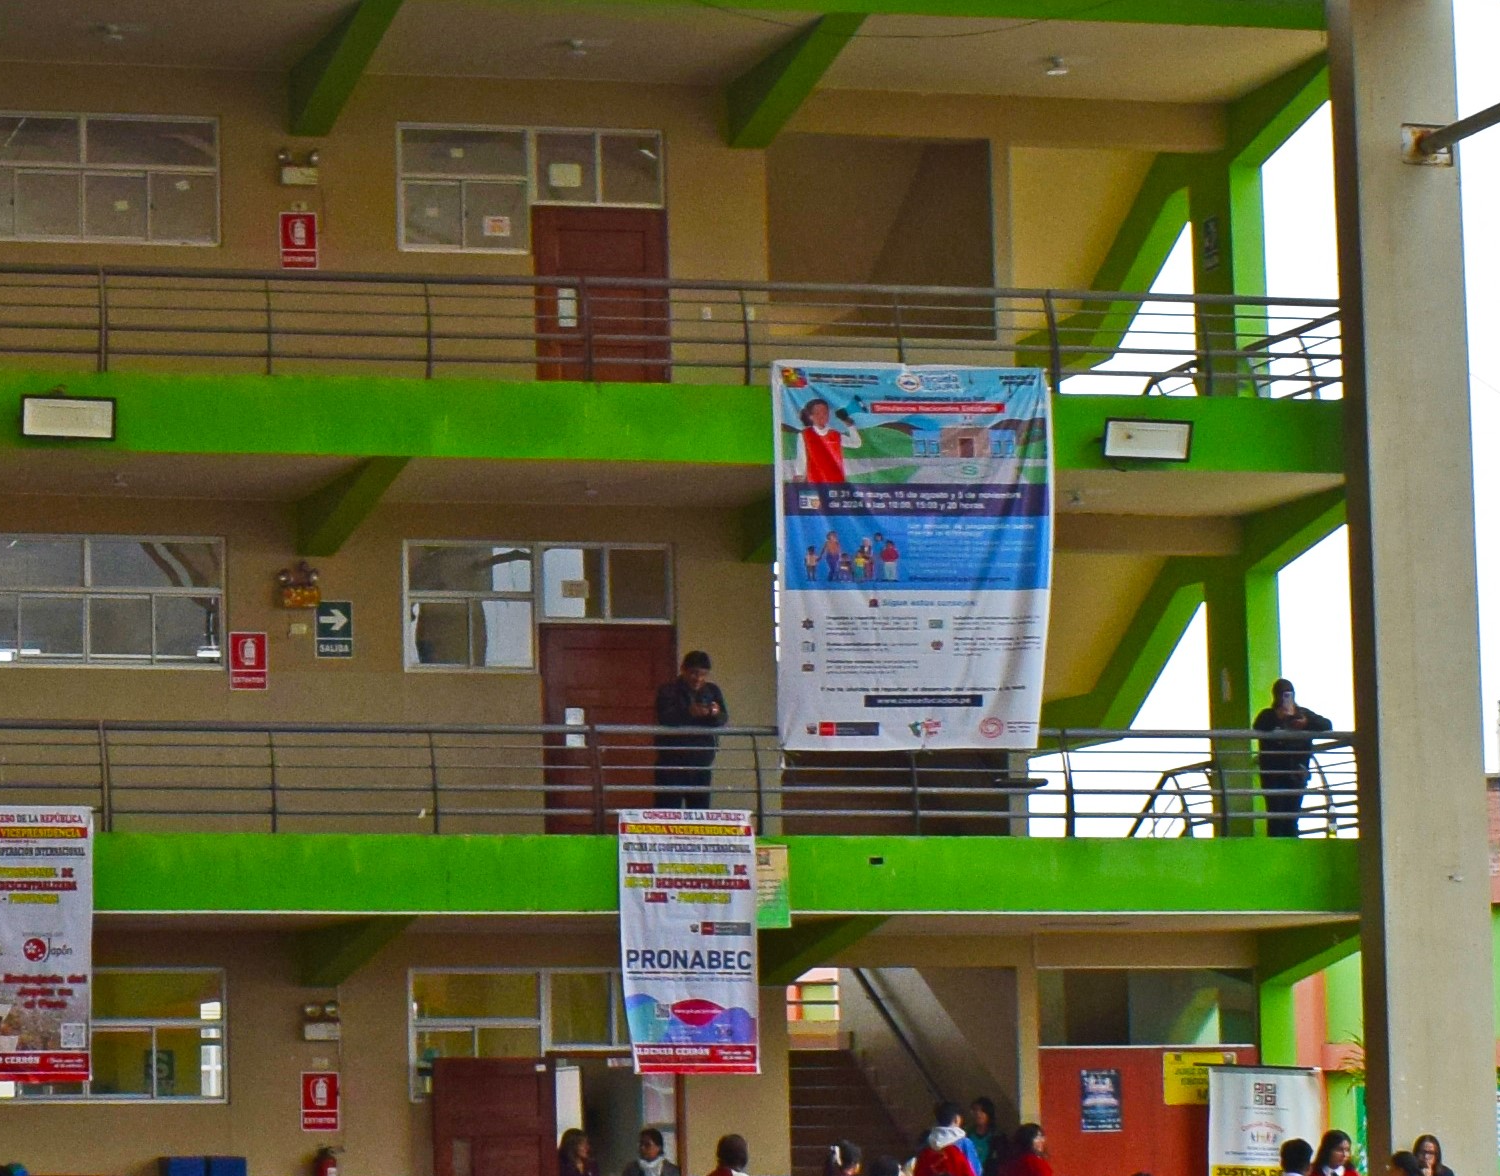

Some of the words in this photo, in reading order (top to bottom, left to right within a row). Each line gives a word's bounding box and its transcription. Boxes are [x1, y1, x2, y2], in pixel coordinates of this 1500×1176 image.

[853, 490, 864, 499] de
[906, 490, 918, 499] de
[919, 491, 949, 501] agosto
[965, 490, 976, 499] de
[829, 500, 841, 509] de
[319, 644, 350, 653] SALIDA
[16, 814, 27, 823] DE
[28, 814, 39, 823] LA
[40, 812, 83, 823] REPÚBLICA
[643, 811, 682, 821] CONGRESO
[683, 812, 693, 821] DE
[695, 812, 705, 821] LA
[1, 827, 82, 838] VICEPRESIDENCIA
[625, 824, 667, 835] SEGUNDA
[669, 824, 746, 836] VICEPRESIDENCIA
[43, 937, 73, 963] Japón
[626, 949, 752, 970] PRONABEC
[4, 1055, 41, 1065] CERRÓN
